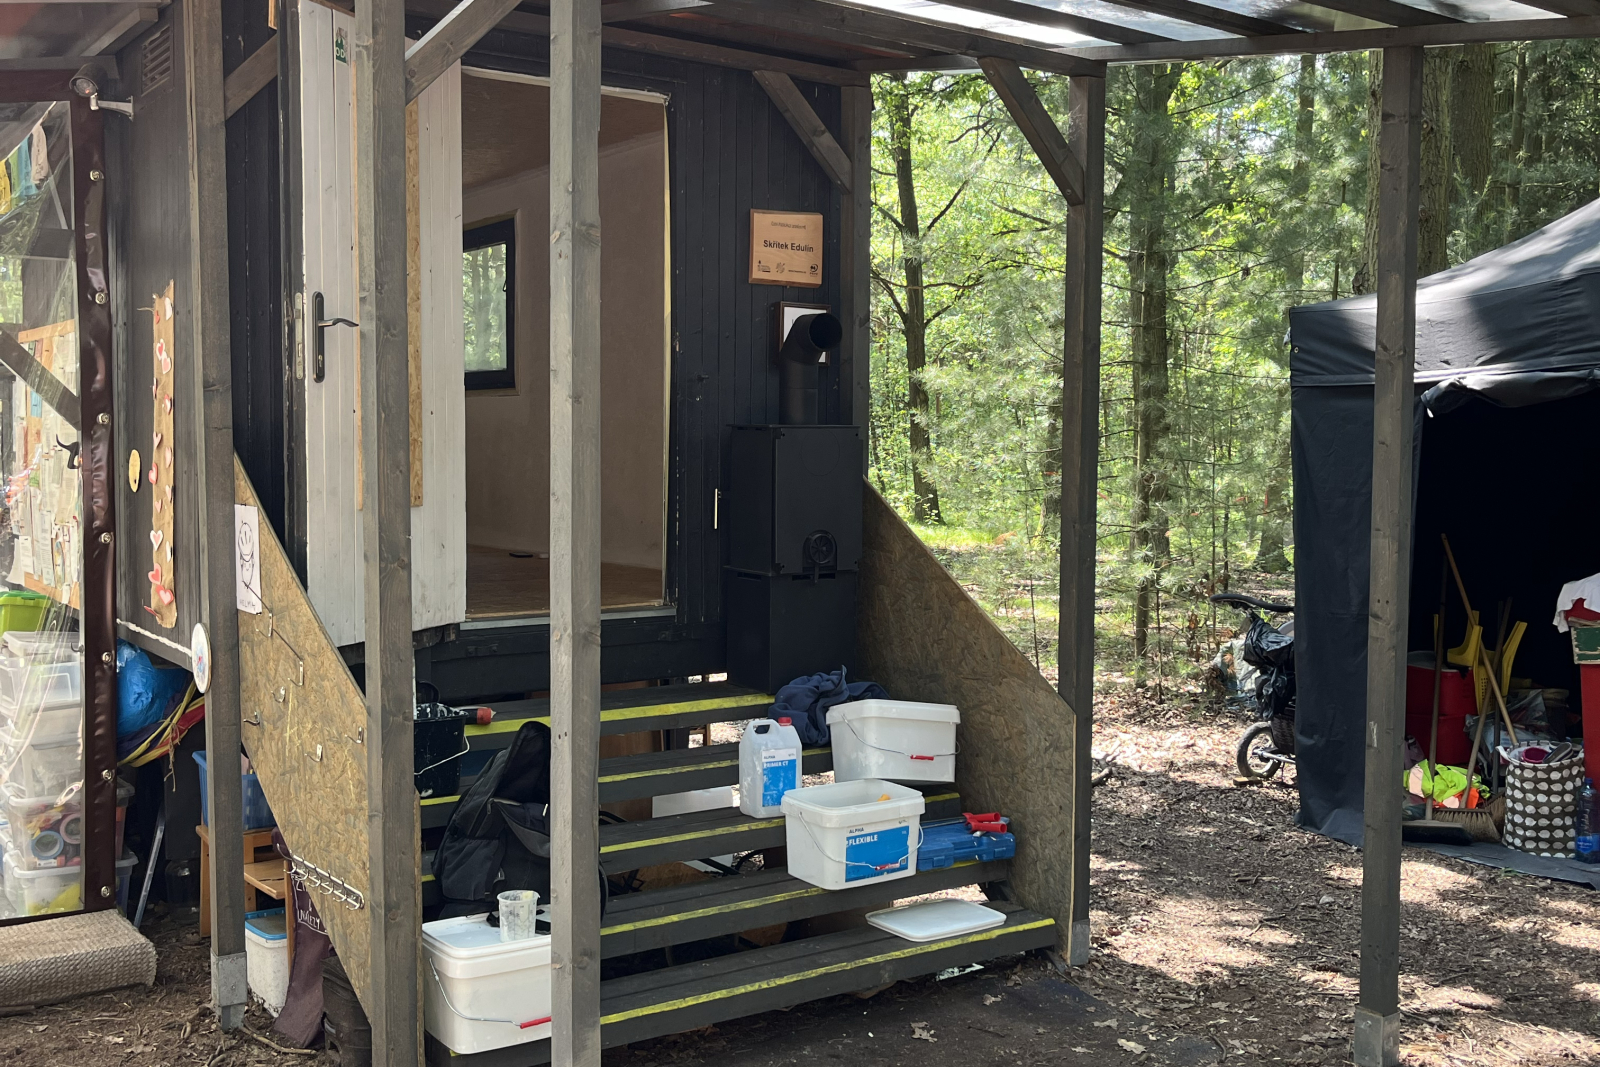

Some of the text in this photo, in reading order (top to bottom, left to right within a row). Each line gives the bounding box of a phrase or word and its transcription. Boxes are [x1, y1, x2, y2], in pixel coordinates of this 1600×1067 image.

[763, 239, 814, 253] Skřítek Edulín
[763, 761, 782, 769] PRIMER
[849, 834, 878, 846] FLEXIBLE
